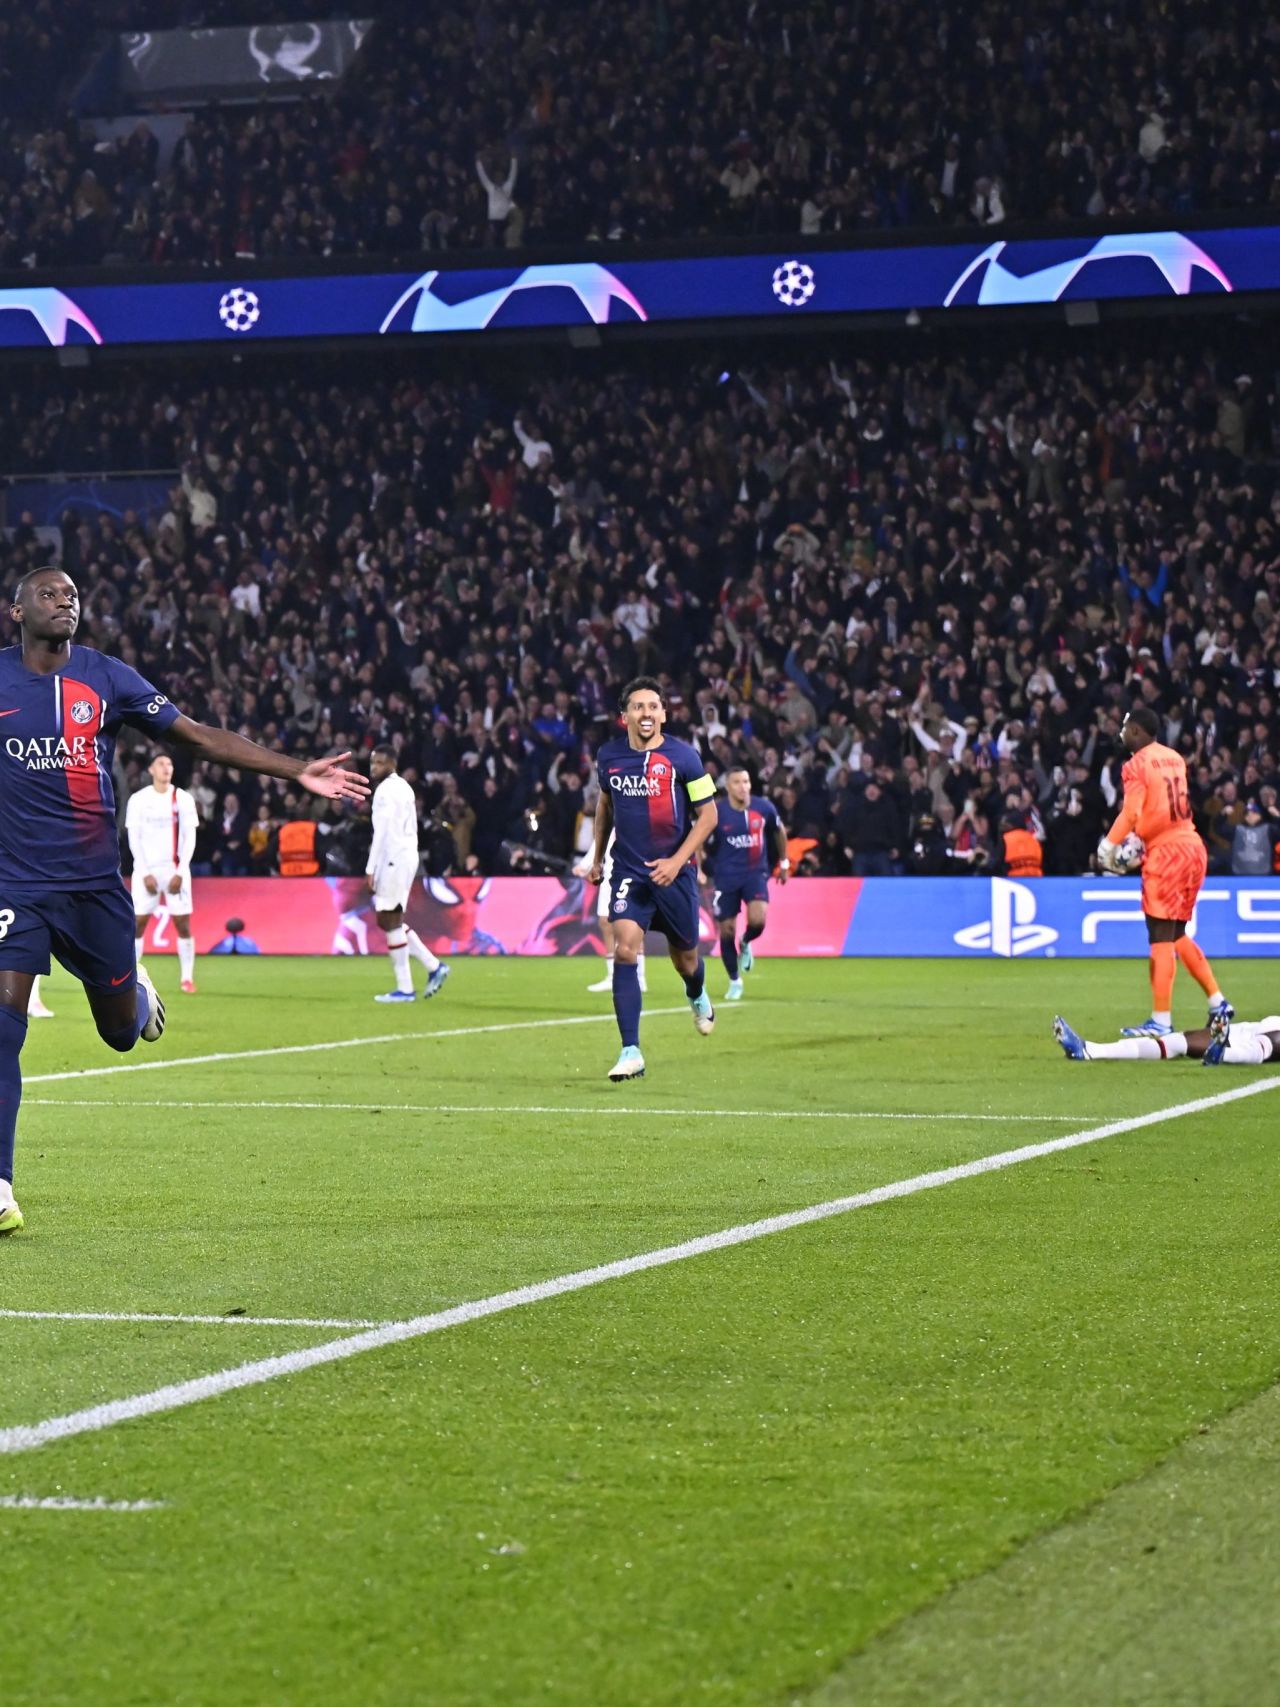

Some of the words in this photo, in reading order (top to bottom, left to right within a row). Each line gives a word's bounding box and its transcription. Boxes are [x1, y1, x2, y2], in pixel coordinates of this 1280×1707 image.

[6, 736, 87, 761] QATAR
[27, 753, 87, 770] AIRWAYS
[610, 775, 660, 791] QATAR
[616, 878, 632, 898] 5
